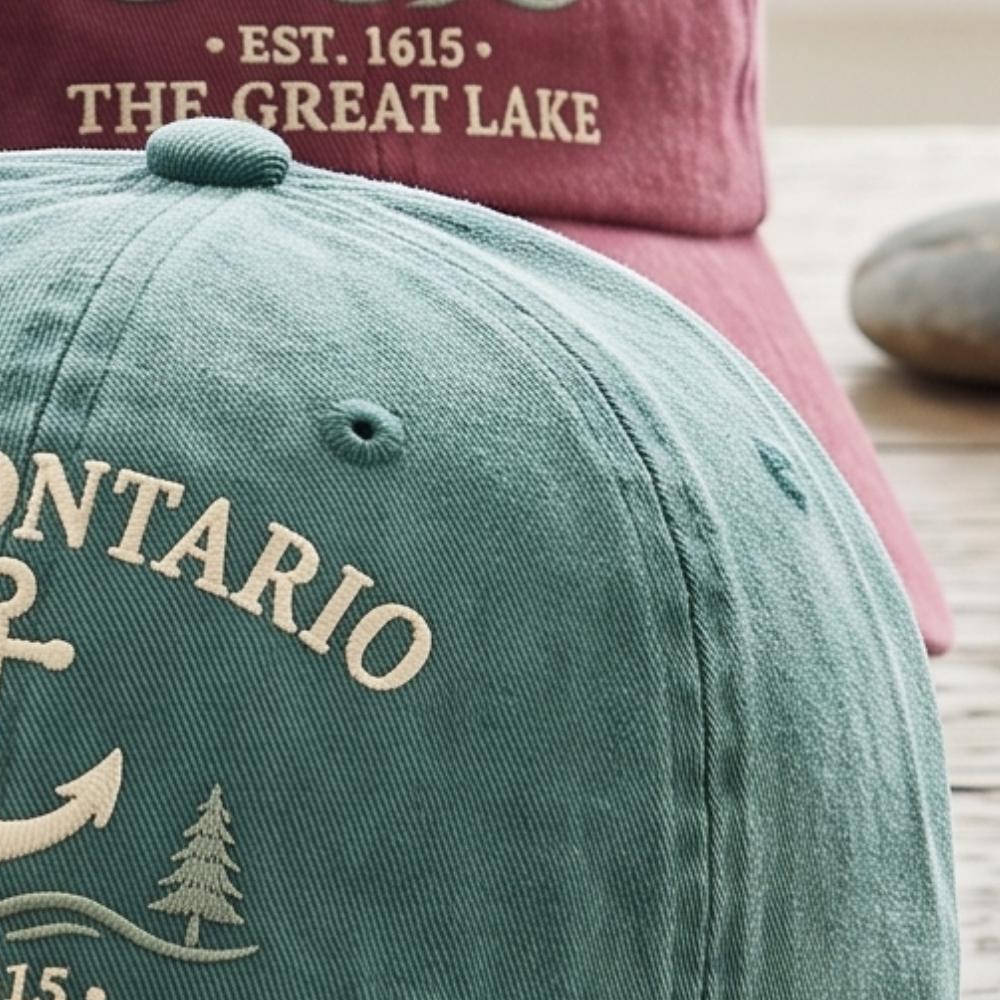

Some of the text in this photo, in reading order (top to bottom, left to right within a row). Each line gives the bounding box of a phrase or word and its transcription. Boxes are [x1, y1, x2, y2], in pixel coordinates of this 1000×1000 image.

[239, 25, 464, 67] EST. 1615
[67, 81, 601, 144] THE GREAT LAKE
